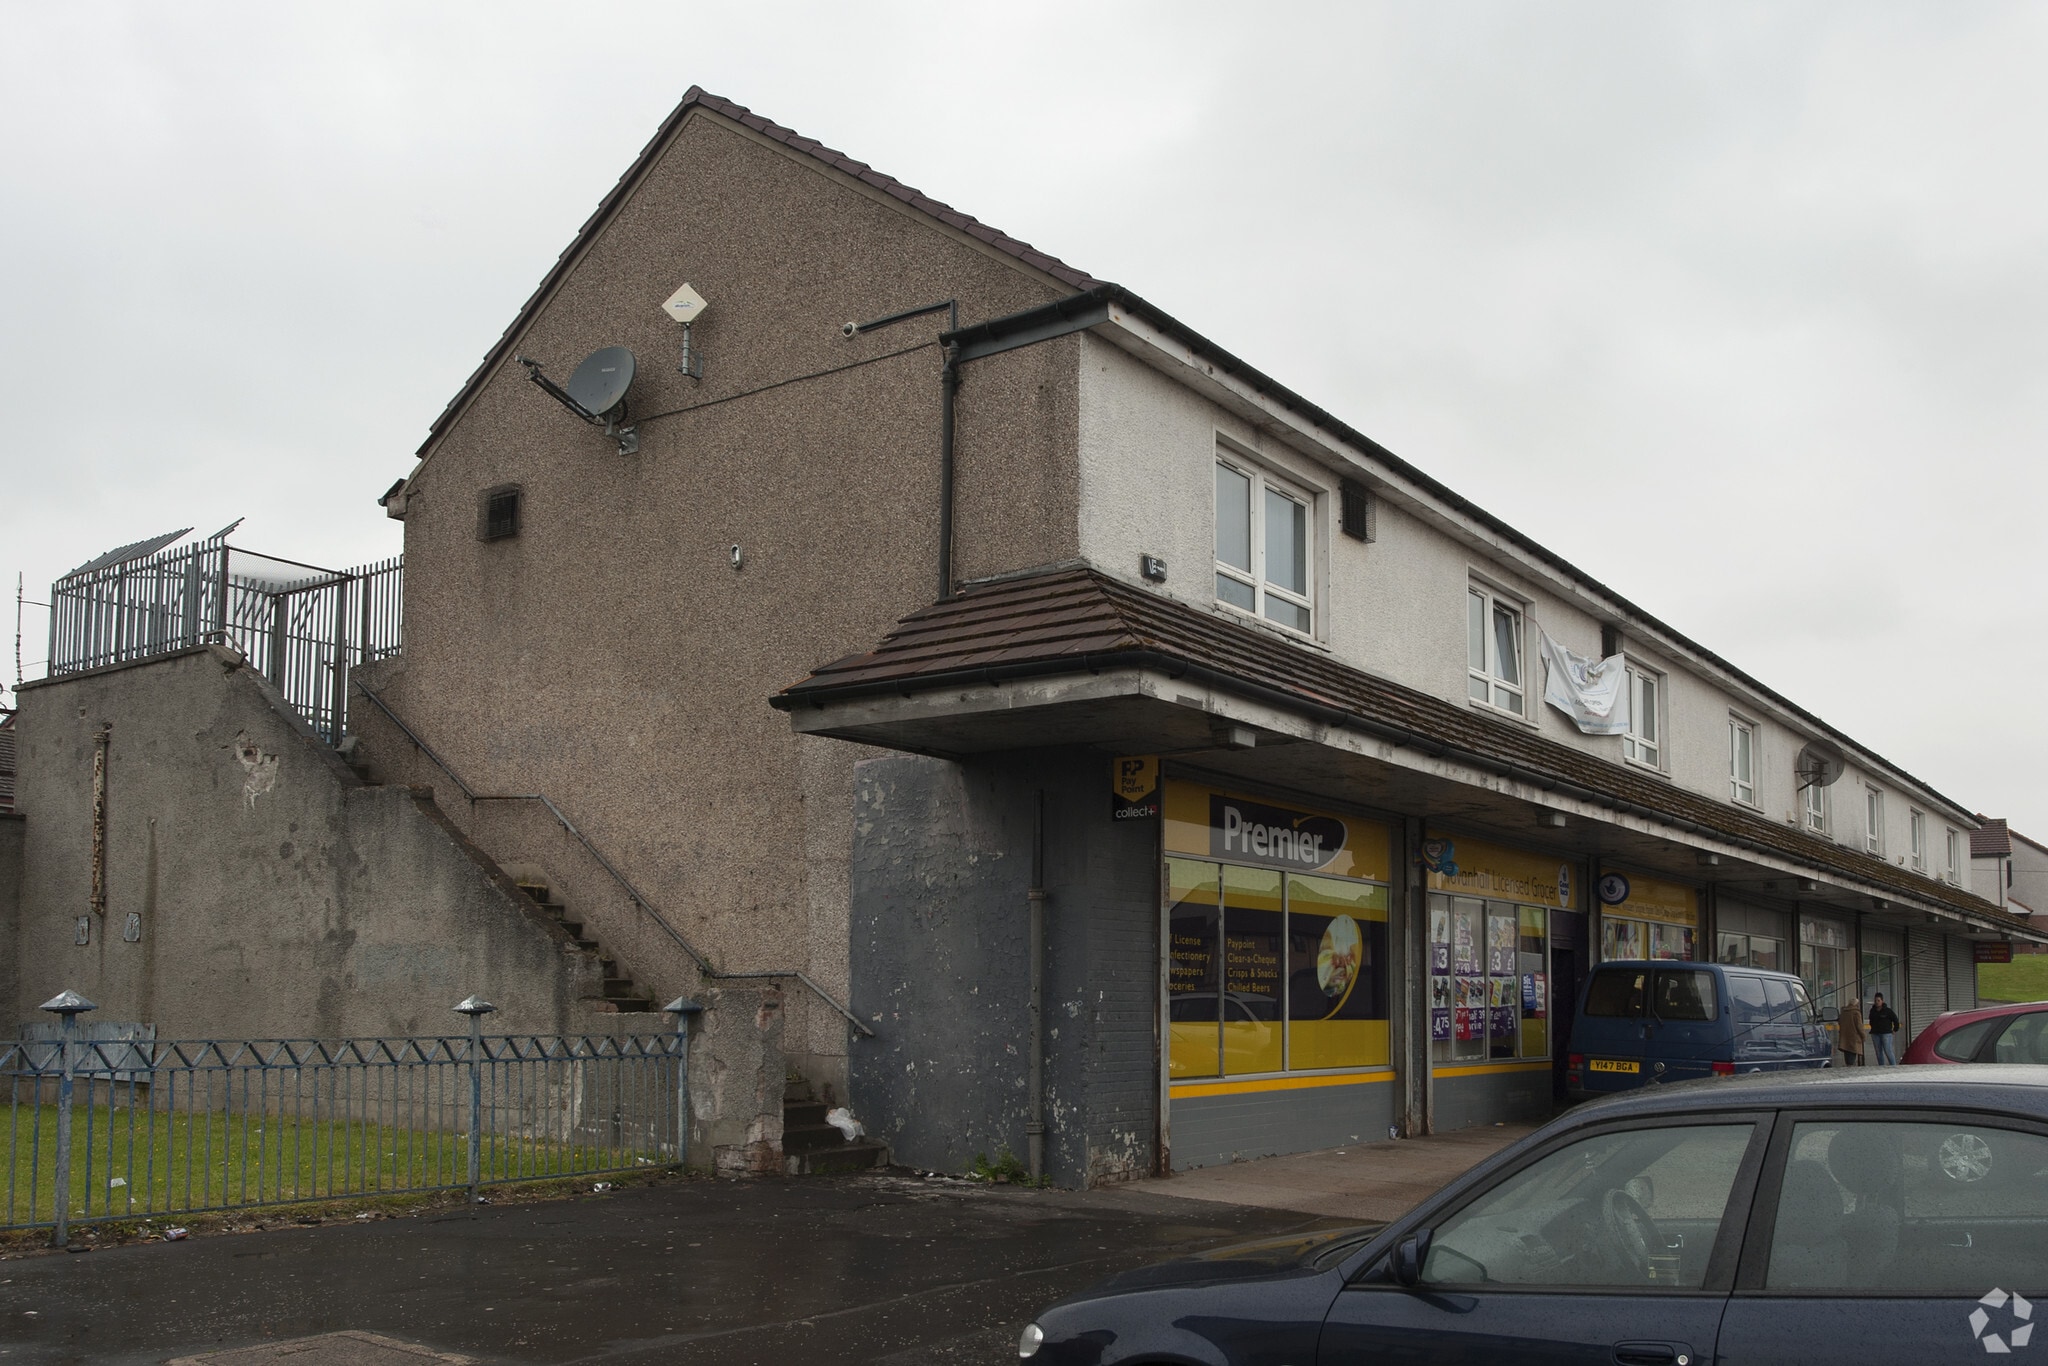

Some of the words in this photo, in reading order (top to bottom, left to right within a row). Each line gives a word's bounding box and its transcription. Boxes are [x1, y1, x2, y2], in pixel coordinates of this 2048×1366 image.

[1121, 777, 1136, 787] Pay
[1121, 784, 1145, 794] Point
[1224, 805, 1324, 864] Premier
[1441, 866, 1490, 890] ovanhall
[1492, 870, 1530, 896] Licensed
[1531, 876, 1558, 901] Grocer
[1174, 935, 1202, 946] License
[1227, 938, 1256, 951] Paypoint
[1169, 949, 1212, 964] nfectionery
[1169, 967, 1205, 978] wspapers
[1227, 967, 1249, 980] Crisps
[1250, 968, 1256, 978] &
[1257, 968, 1279, 979] Snacks
[1169, 980, 1196, 991] oceries
[1227, 982, 1251, 993] Chilled
[1251, 983, 1271, 993] Beers
[1616, 1061, 1633, 1072] BGA
